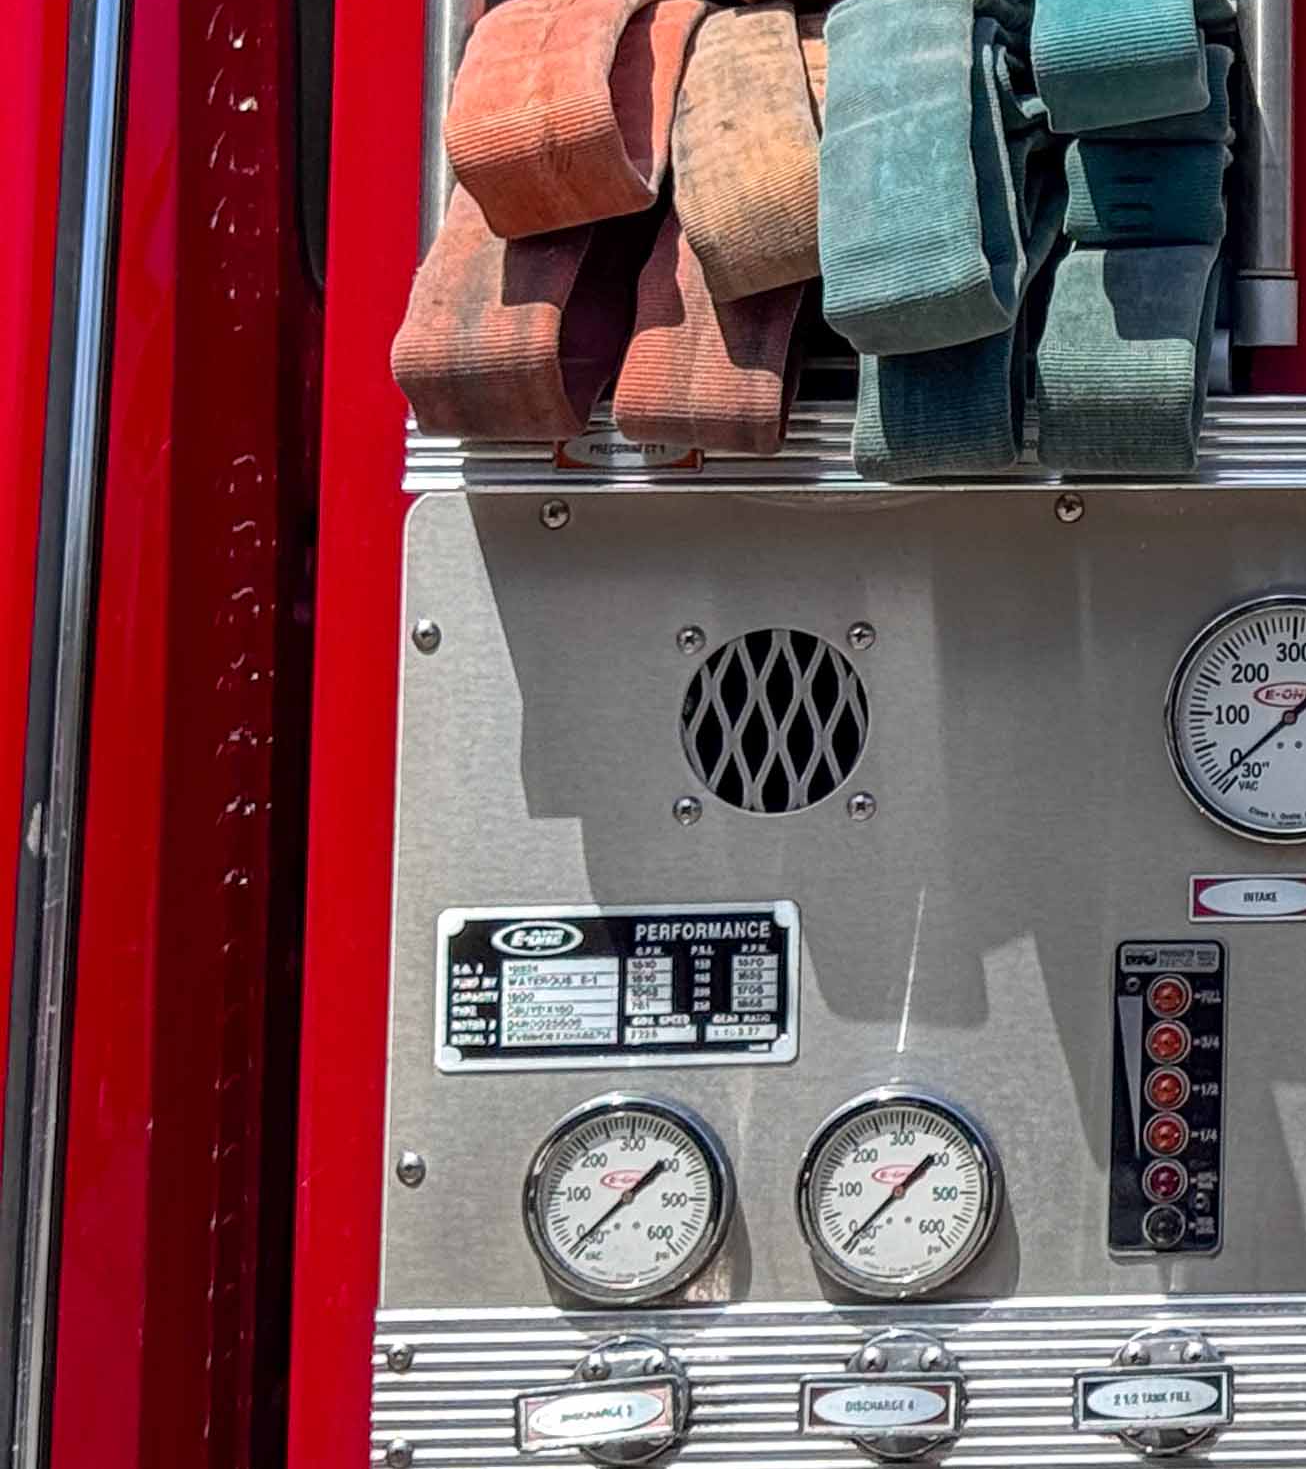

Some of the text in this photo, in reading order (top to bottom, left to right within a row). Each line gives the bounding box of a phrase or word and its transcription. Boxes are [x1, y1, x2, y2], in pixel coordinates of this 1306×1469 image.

[1231, 664, 1269, 683] 200
[1214, 705, 1249, 725] 100
[1230, 748, 1241, 768] 0
[1239, 780, 1258, 791] VAC
[1243, 891, 1277, 902] INTAKE
[635, 921, 771, 941] PERFORMANCE
[1201, 1036, 1219, 1049] 3/4
[1201, 1083, 1219, 1096] 1/2
[890, 1132, 915, 1146] 300
[1200, 1129, 1217, 1141] 1/4
[620, 1138, 645, 1151] 300
[582, 1153, 607, 1168] 200
[852, 1149, 878, 1163] 200
[566, 1187, 590, 1201] 100
[838, 1182, 862, 1196] 100
[933, 1187, 958, 1201] 500
[662, 1193, 687, 1208] 500
[647, 1225, 673, 1239] 600
[919, 1219, 944, 1233] 600
[845, 1399, 904, 1412] DISCHARGE
[1113, 1391, 1192, 1406] 2 1/2 TANK FILL
